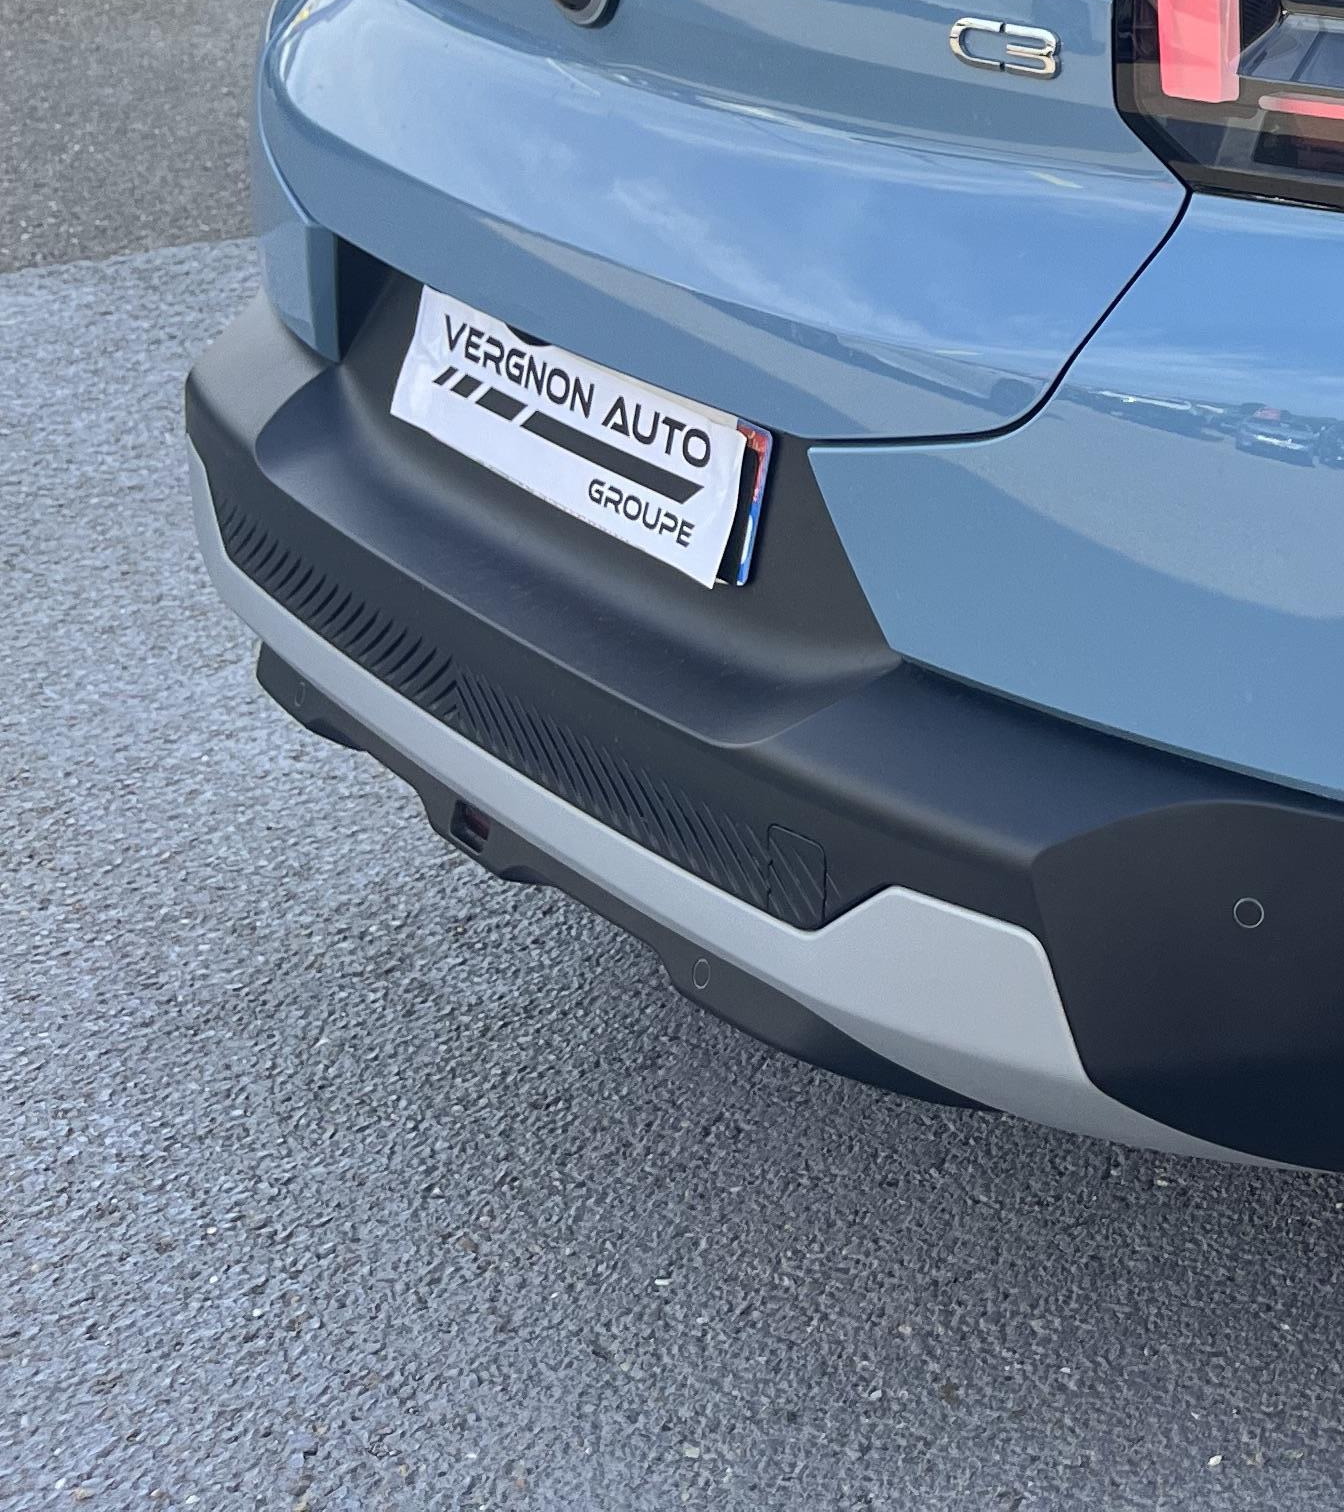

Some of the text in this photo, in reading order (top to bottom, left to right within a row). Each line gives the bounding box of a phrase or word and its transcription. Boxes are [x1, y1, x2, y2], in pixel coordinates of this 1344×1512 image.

[950, 17, 1062, 80] C3
[445, 314, 711, 468] VERGNON AUTO
[588, 479, 696, 548] GROUPE
